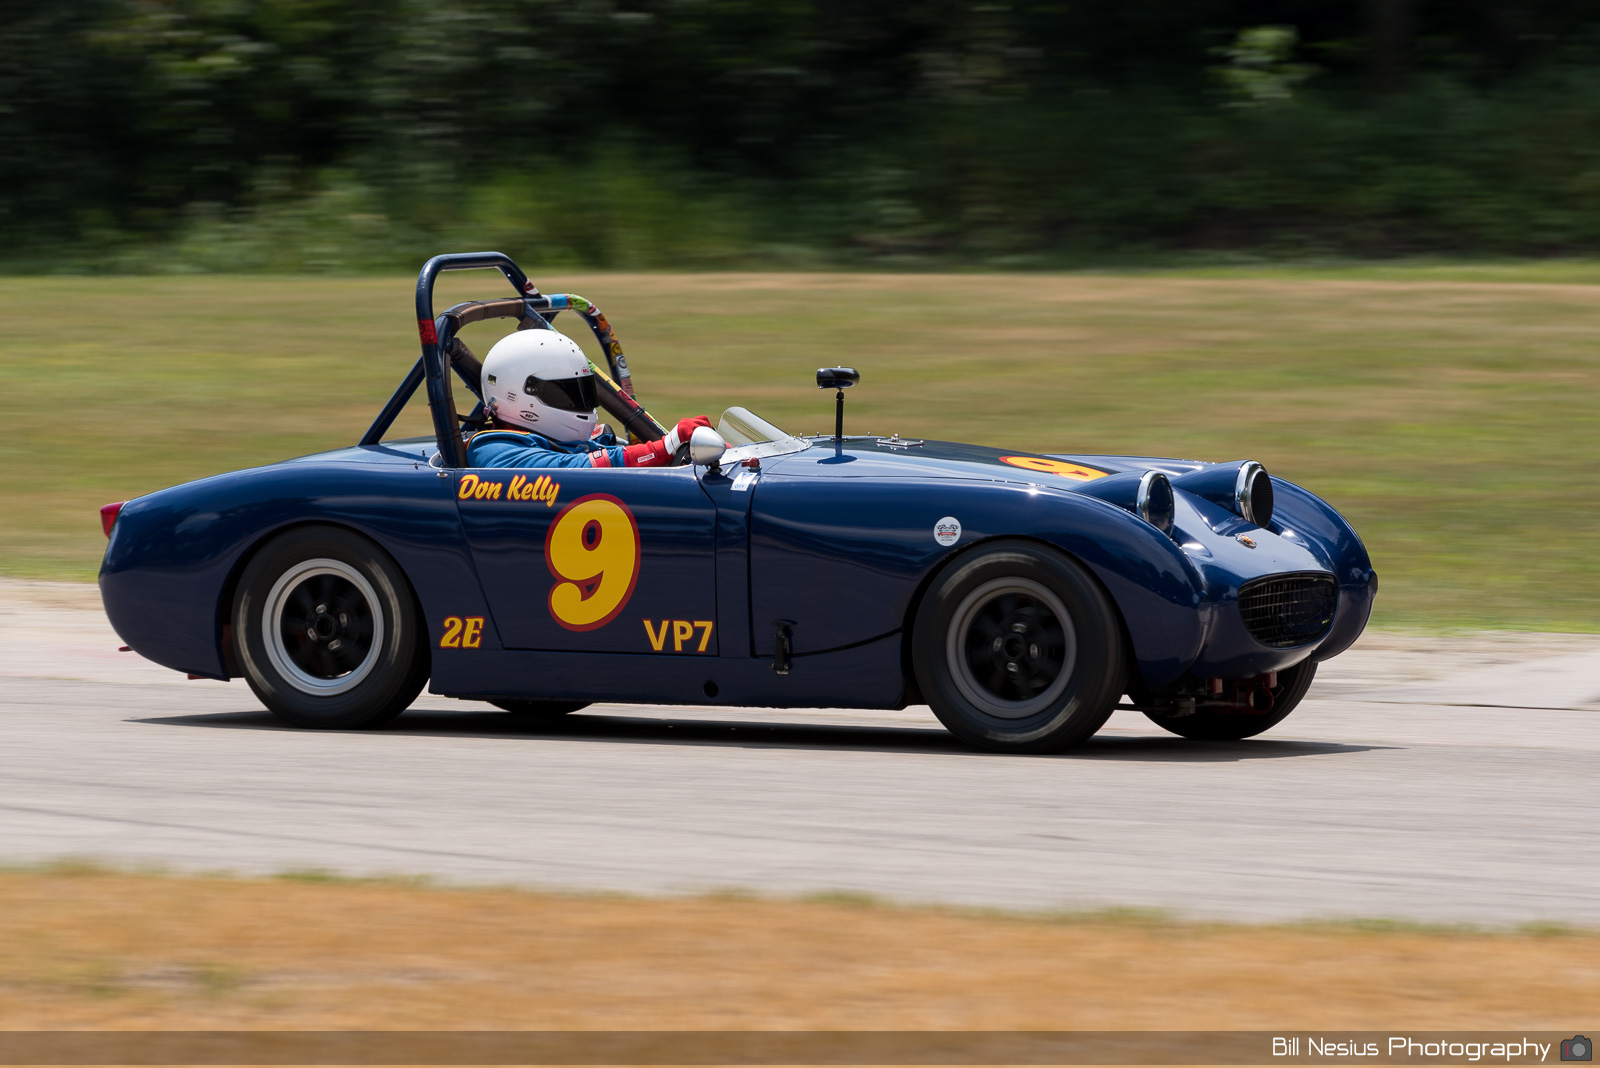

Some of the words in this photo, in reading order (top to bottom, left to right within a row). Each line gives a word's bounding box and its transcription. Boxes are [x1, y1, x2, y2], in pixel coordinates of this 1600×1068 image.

[999, 455, 1111, 482] 9
[458, 474, 502, 500] Don
[507, 474, 561, 507] Kelly
[545, 493, 641, 632] 9
[439, 616, 485, 649] 2E
[643, 618, 713, 652] VP7
